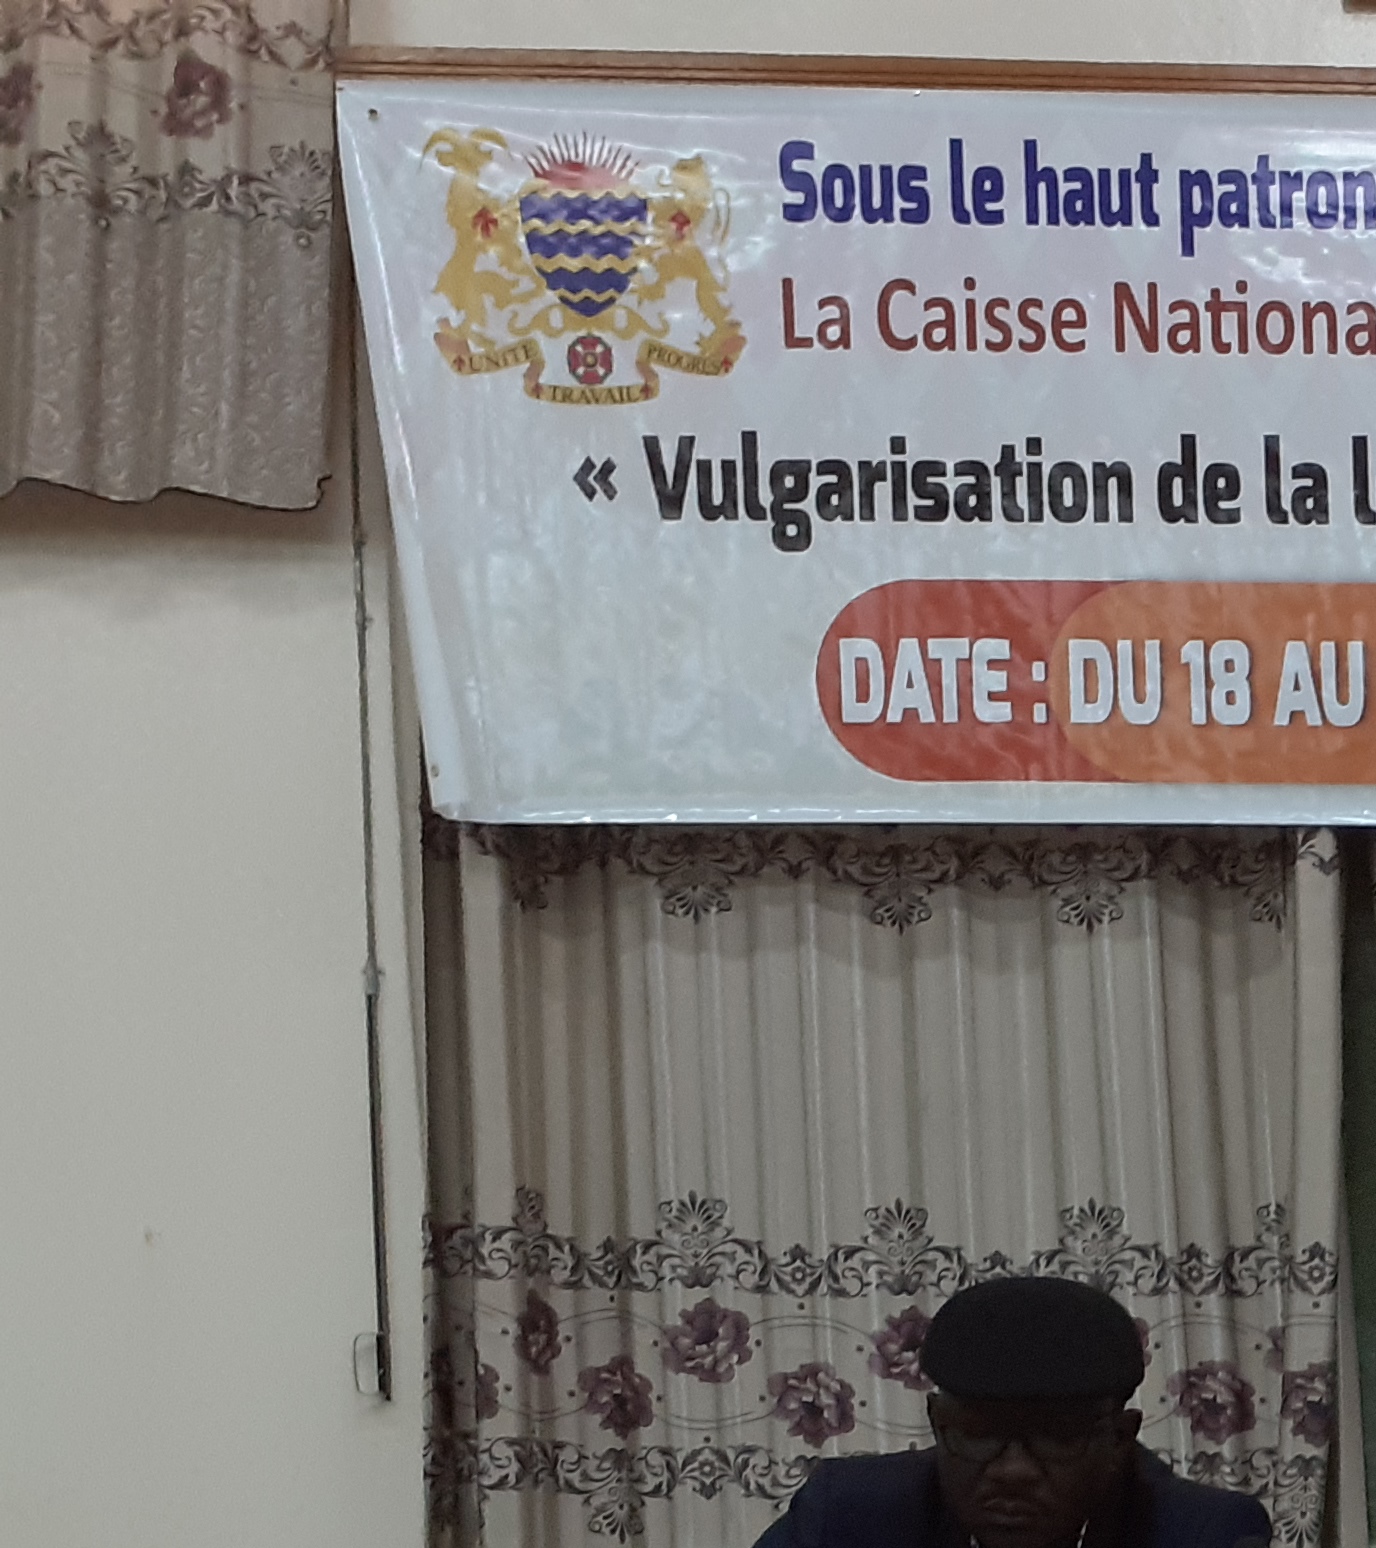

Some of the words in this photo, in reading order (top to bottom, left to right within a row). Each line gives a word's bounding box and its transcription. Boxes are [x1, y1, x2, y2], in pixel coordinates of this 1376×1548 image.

[779, 140, 930, 225] Sous
[949, 138, 1004, 225] le
[1023, 139, 1160, 227] haut
[782, 277, 851, 350] La
[877, 277, 1087, 353] Caisse
[549, 385, 641, 404] TRAVAIL
[643, 431, 1133, 552] Vulgarisation
[1158, 434, 1240, 524] de
[1264, 435, 1329, 525] la
[839, 638, 1012, 722] DATE
[1069, 639, 1161, 724] DU
[1181, 640, 1250, 725] 18
[1274, 641, 1364, 726] AU
